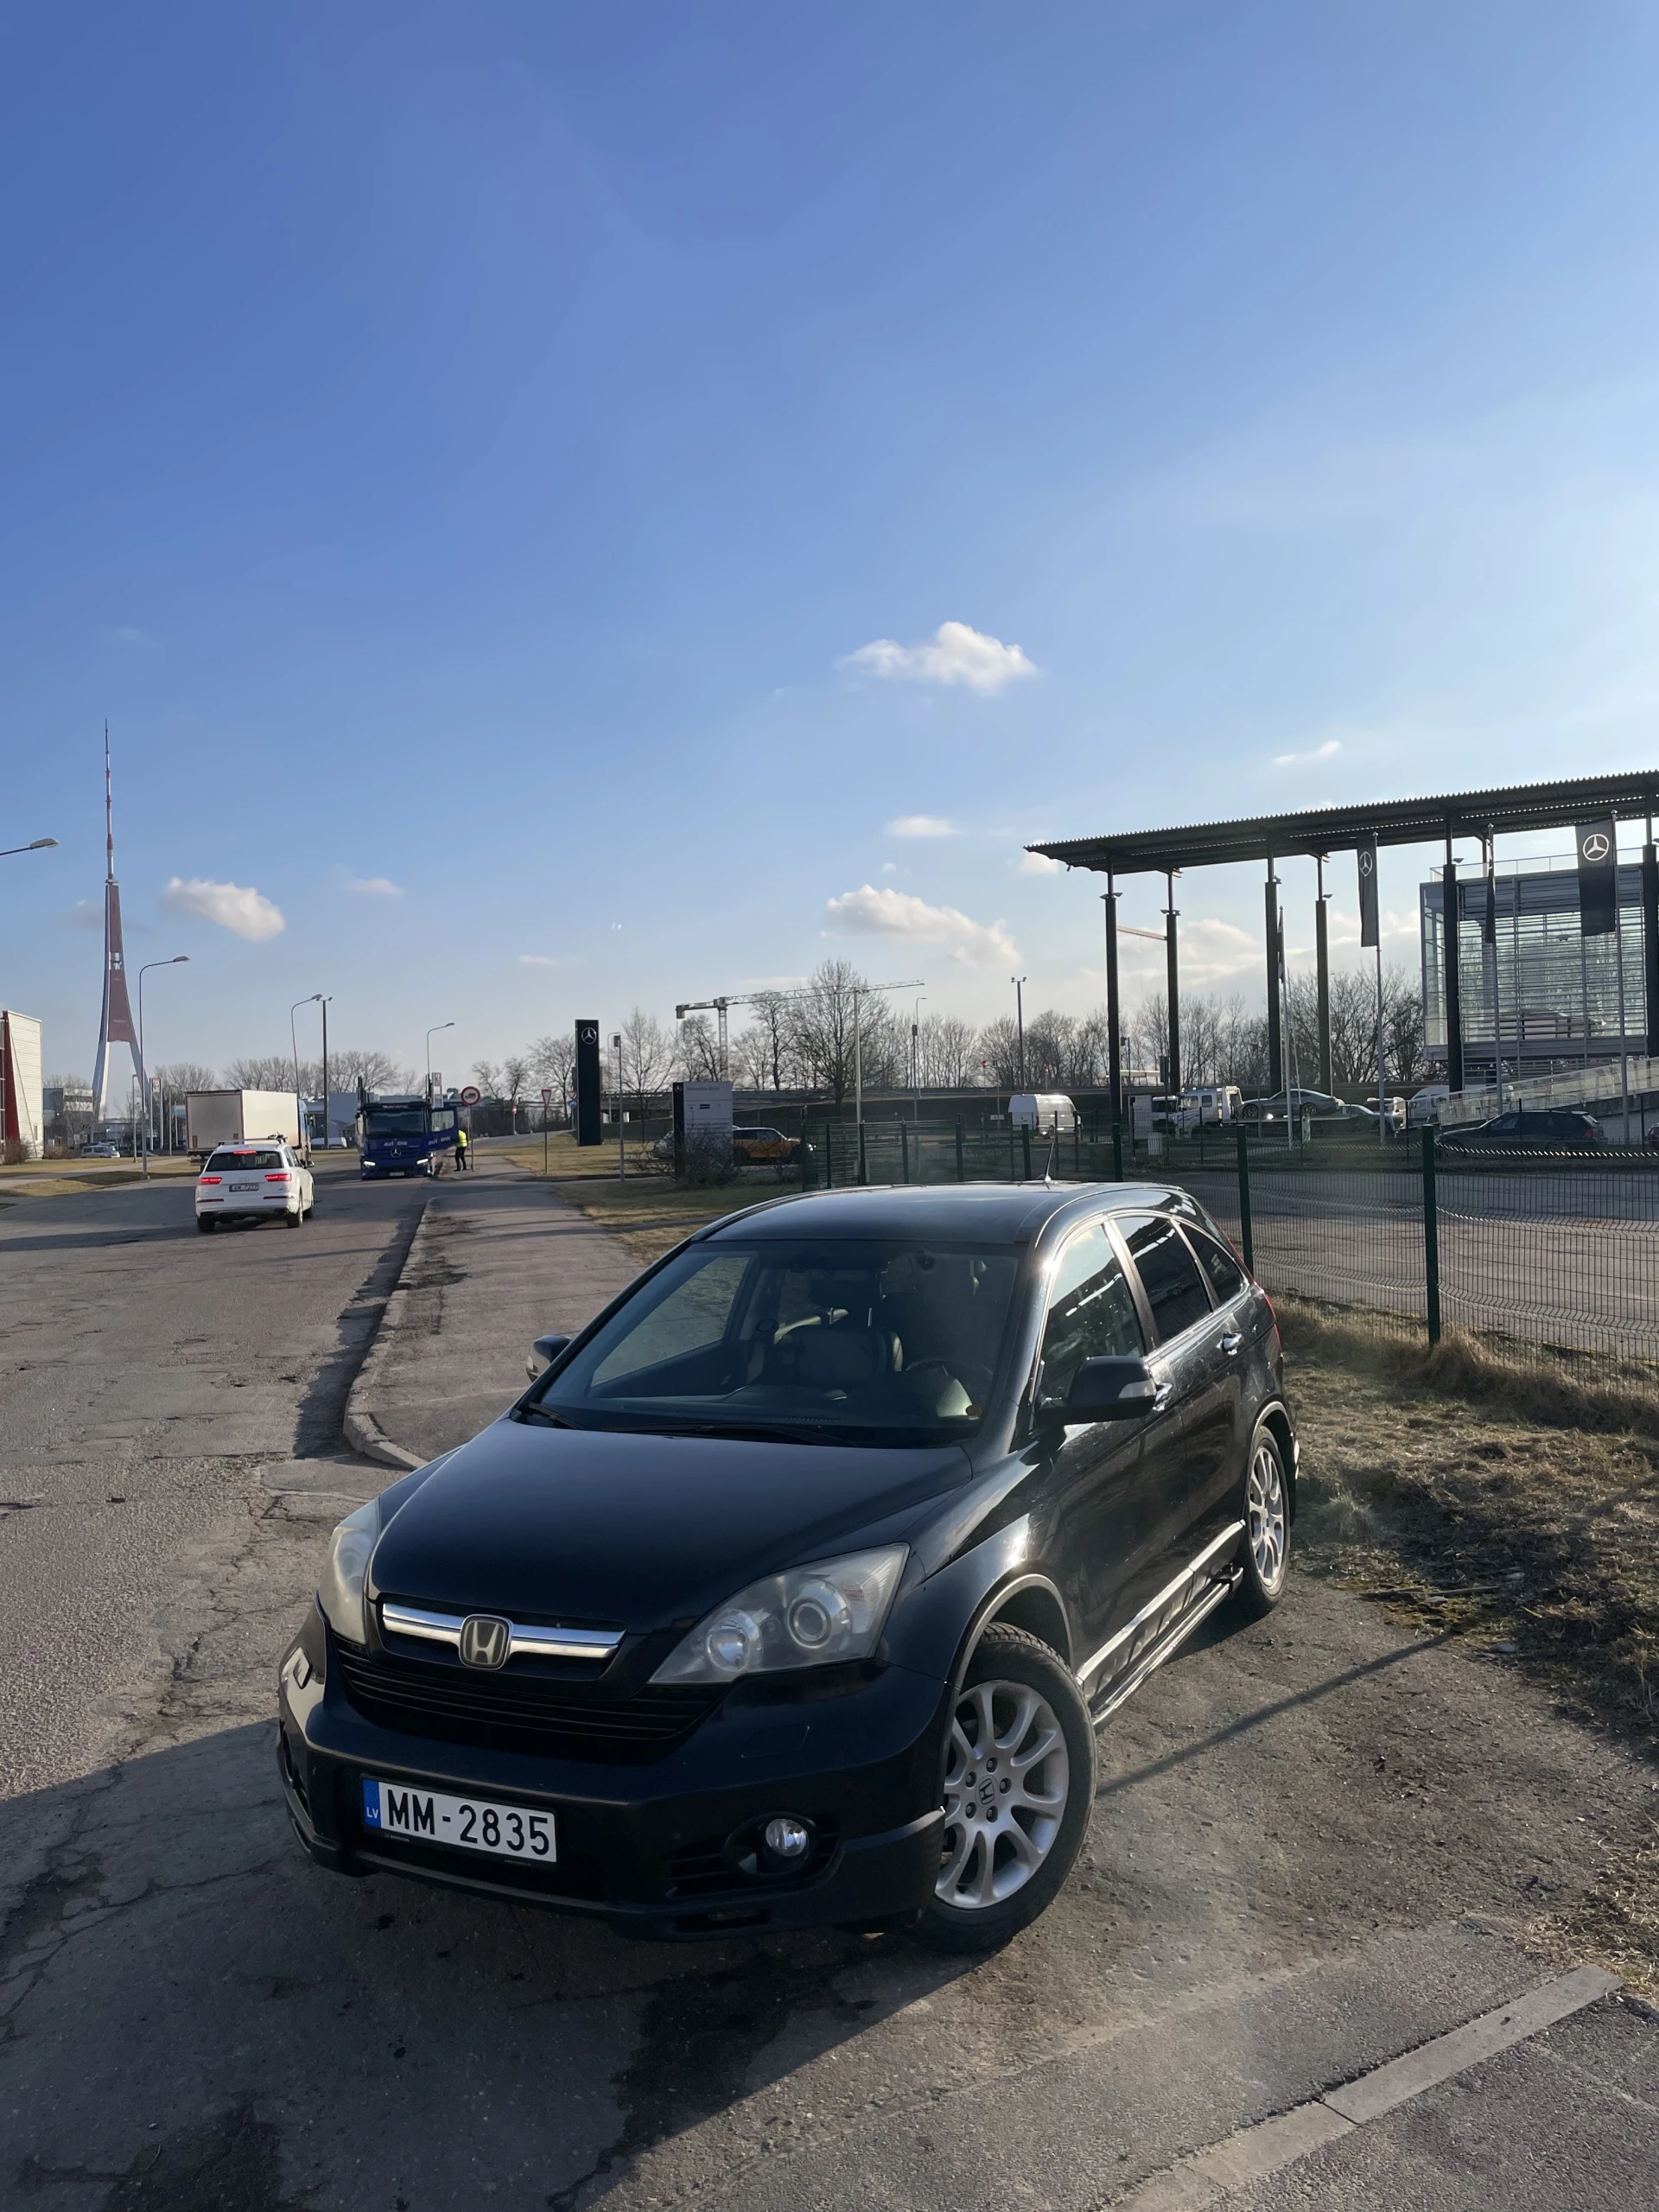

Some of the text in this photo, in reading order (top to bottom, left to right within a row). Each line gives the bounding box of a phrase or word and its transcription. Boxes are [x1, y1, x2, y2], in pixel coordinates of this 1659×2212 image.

[428, 1135, 451, 1146] autlink
[366, 1807, 378, 1819] LV
[387, 1789, 550, 1856] MM-2835
